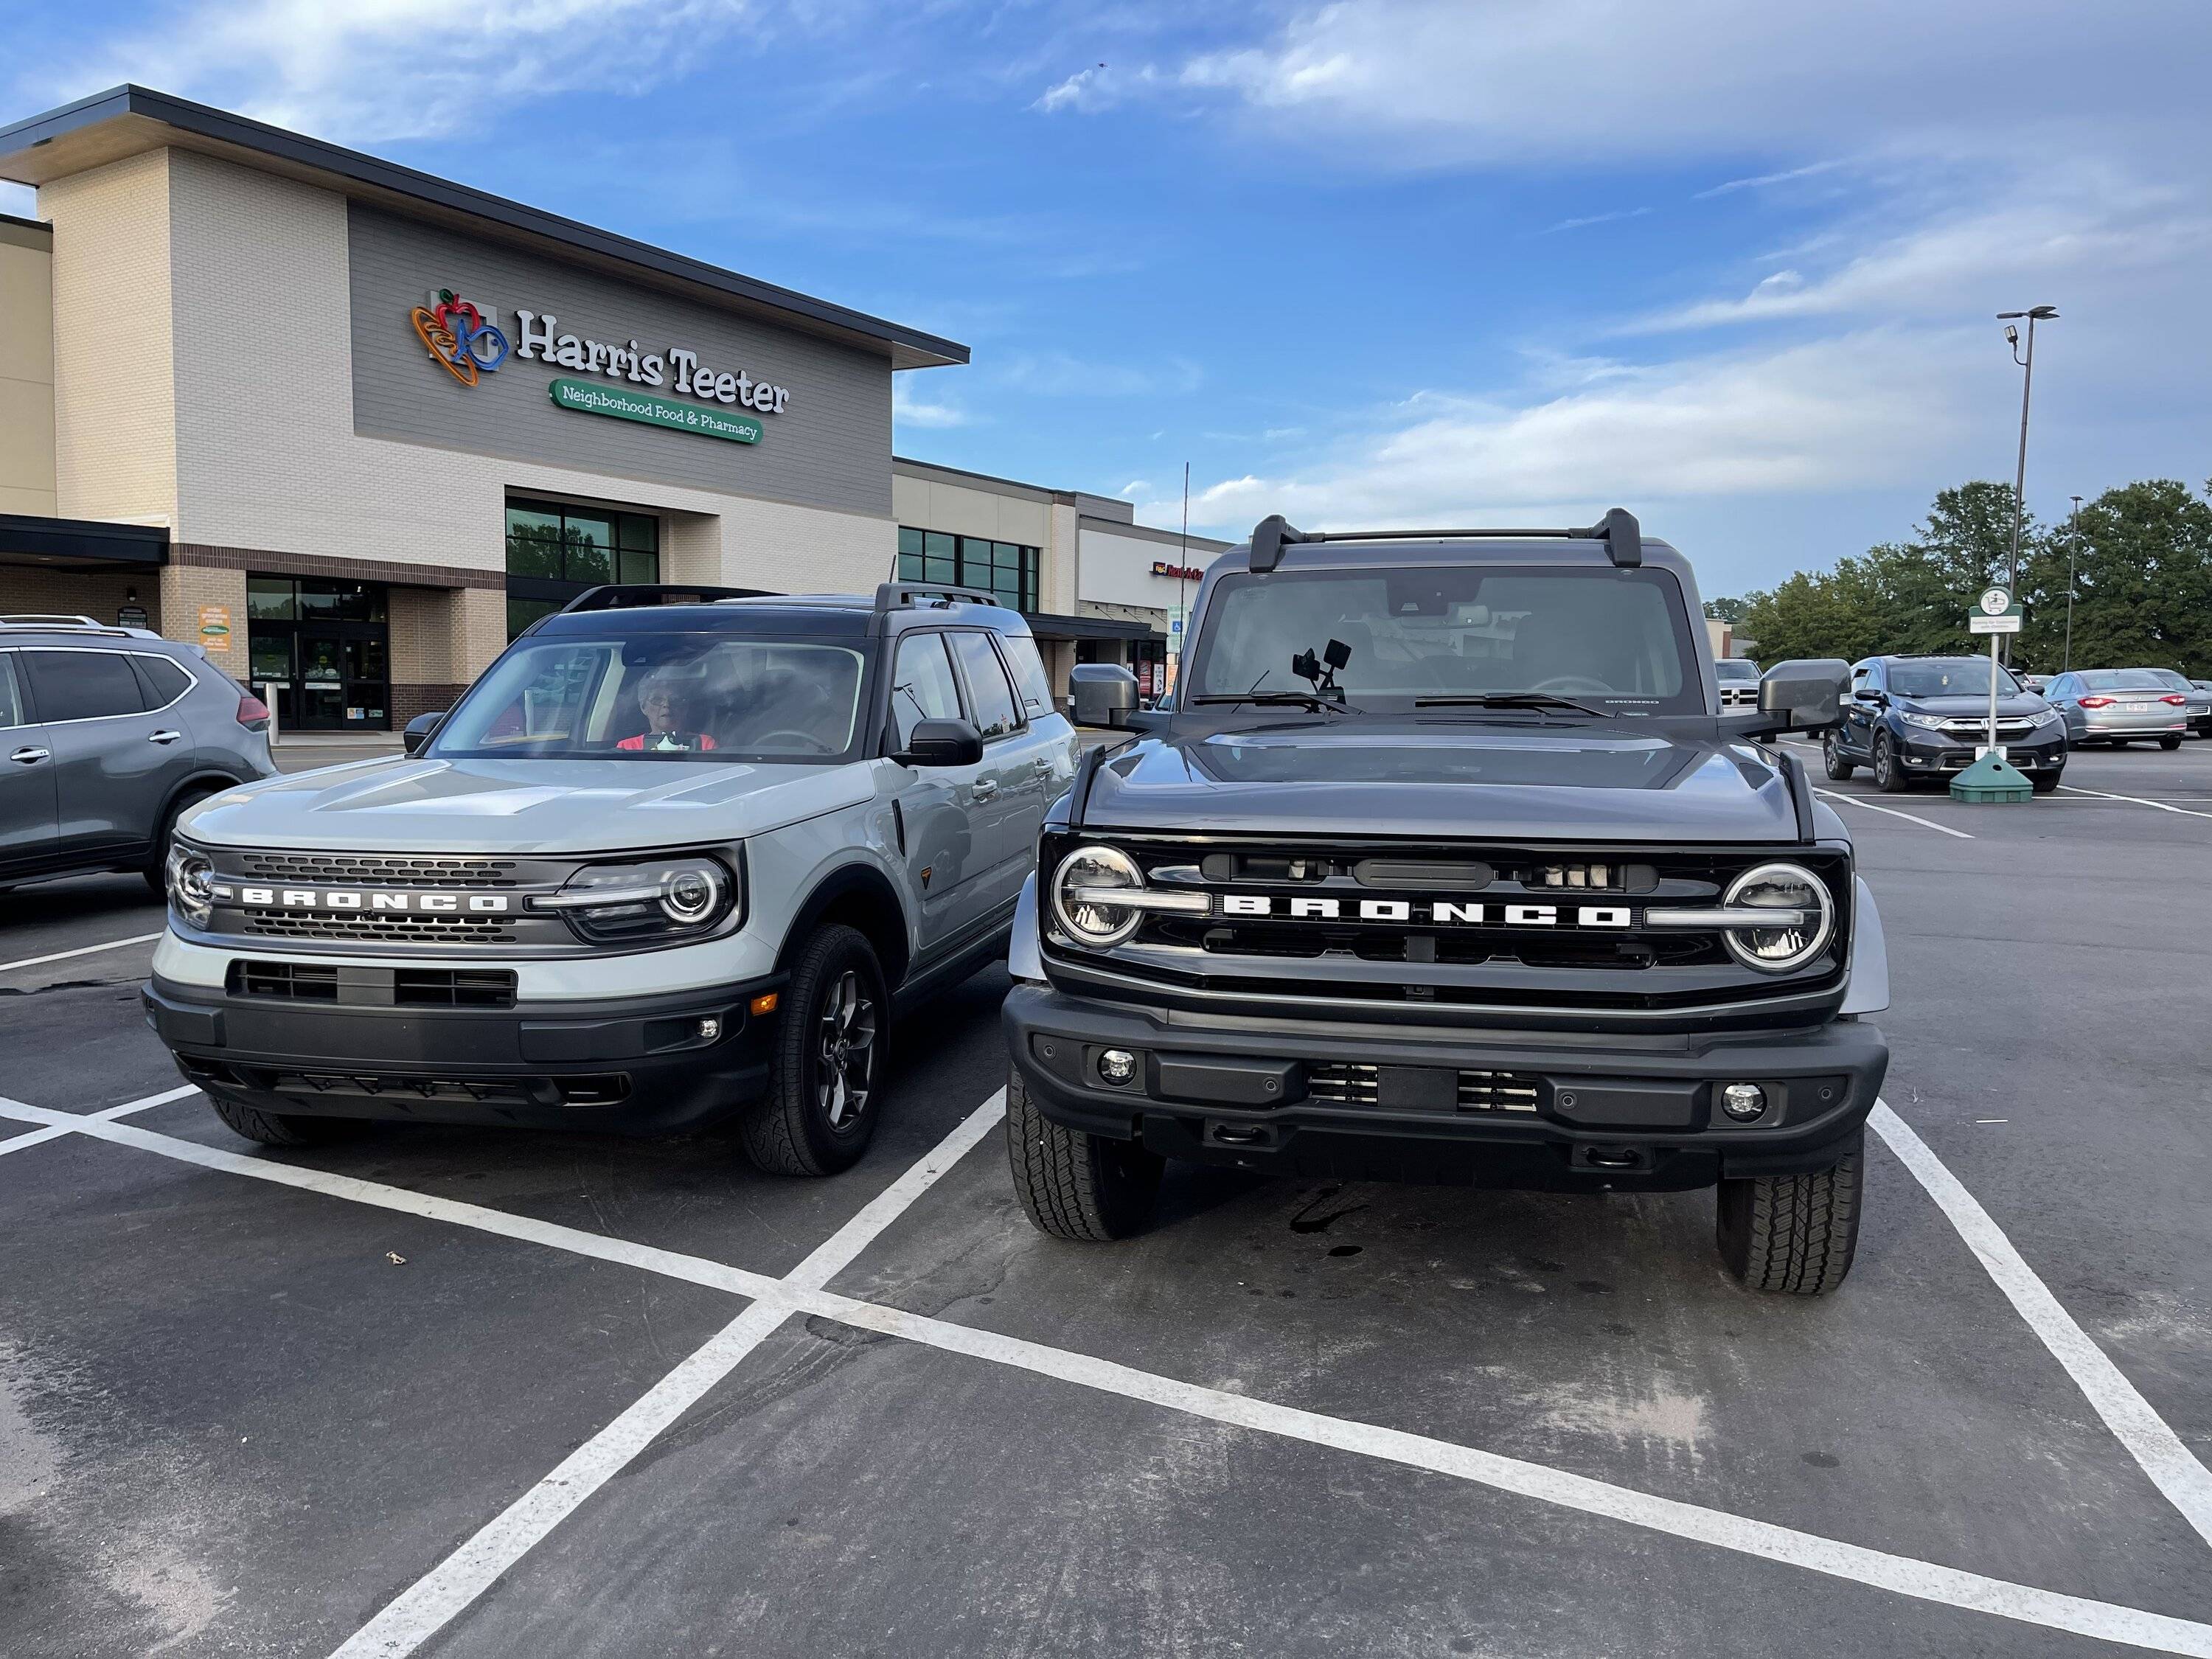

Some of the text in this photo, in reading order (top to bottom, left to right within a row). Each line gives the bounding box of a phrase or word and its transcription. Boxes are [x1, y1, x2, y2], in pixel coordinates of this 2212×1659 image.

[516, 310, 790, 414] Harris Teeter
[563, 386, 758, 441] Neighborhood Food & Pharmacy
[242, 888, 509, 911] BRONCO
[1223, 894, 1632, 927] BRONCO
